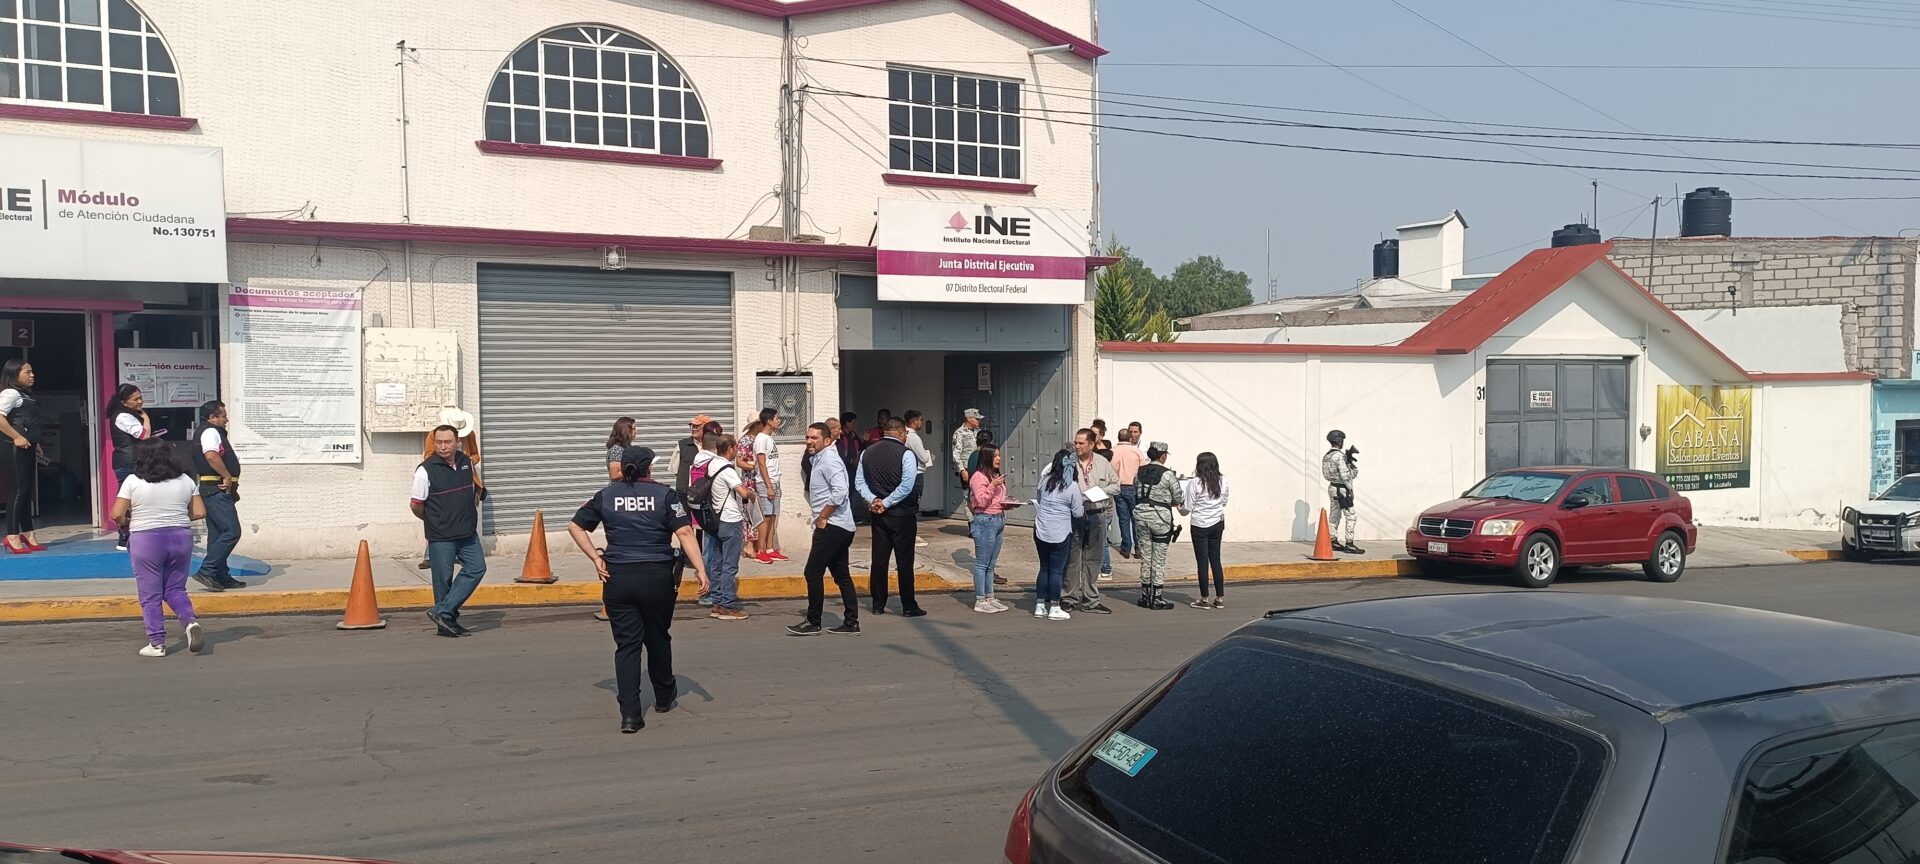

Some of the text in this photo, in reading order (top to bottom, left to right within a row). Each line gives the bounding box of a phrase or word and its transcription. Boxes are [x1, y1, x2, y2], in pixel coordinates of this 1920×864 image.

[58, 188, 140, 207] Módulo
[59, 209, 195, 225] de Atención Ciudadana
[153, 227, 216, 238] No.130751
[975, 216, 1030, 236] INE
[943, 236, 971, 244] Instituto
[939, 258, 1035, 272] Junta Distrital Ejecutiva
[235, 286, 355, 299] Documentos aceptados
[945, 283, 1028, 294] 07 Distrito Electoral Federal
[18, 328, 28, 339] 2
[1477, 386, 1485, 400] 31
[1670, 425, 1740, 449] CABAÑA
[1670, 448, 1740, 463] Salón para Eventos
[614, 497, 654, 511] PIBEH
